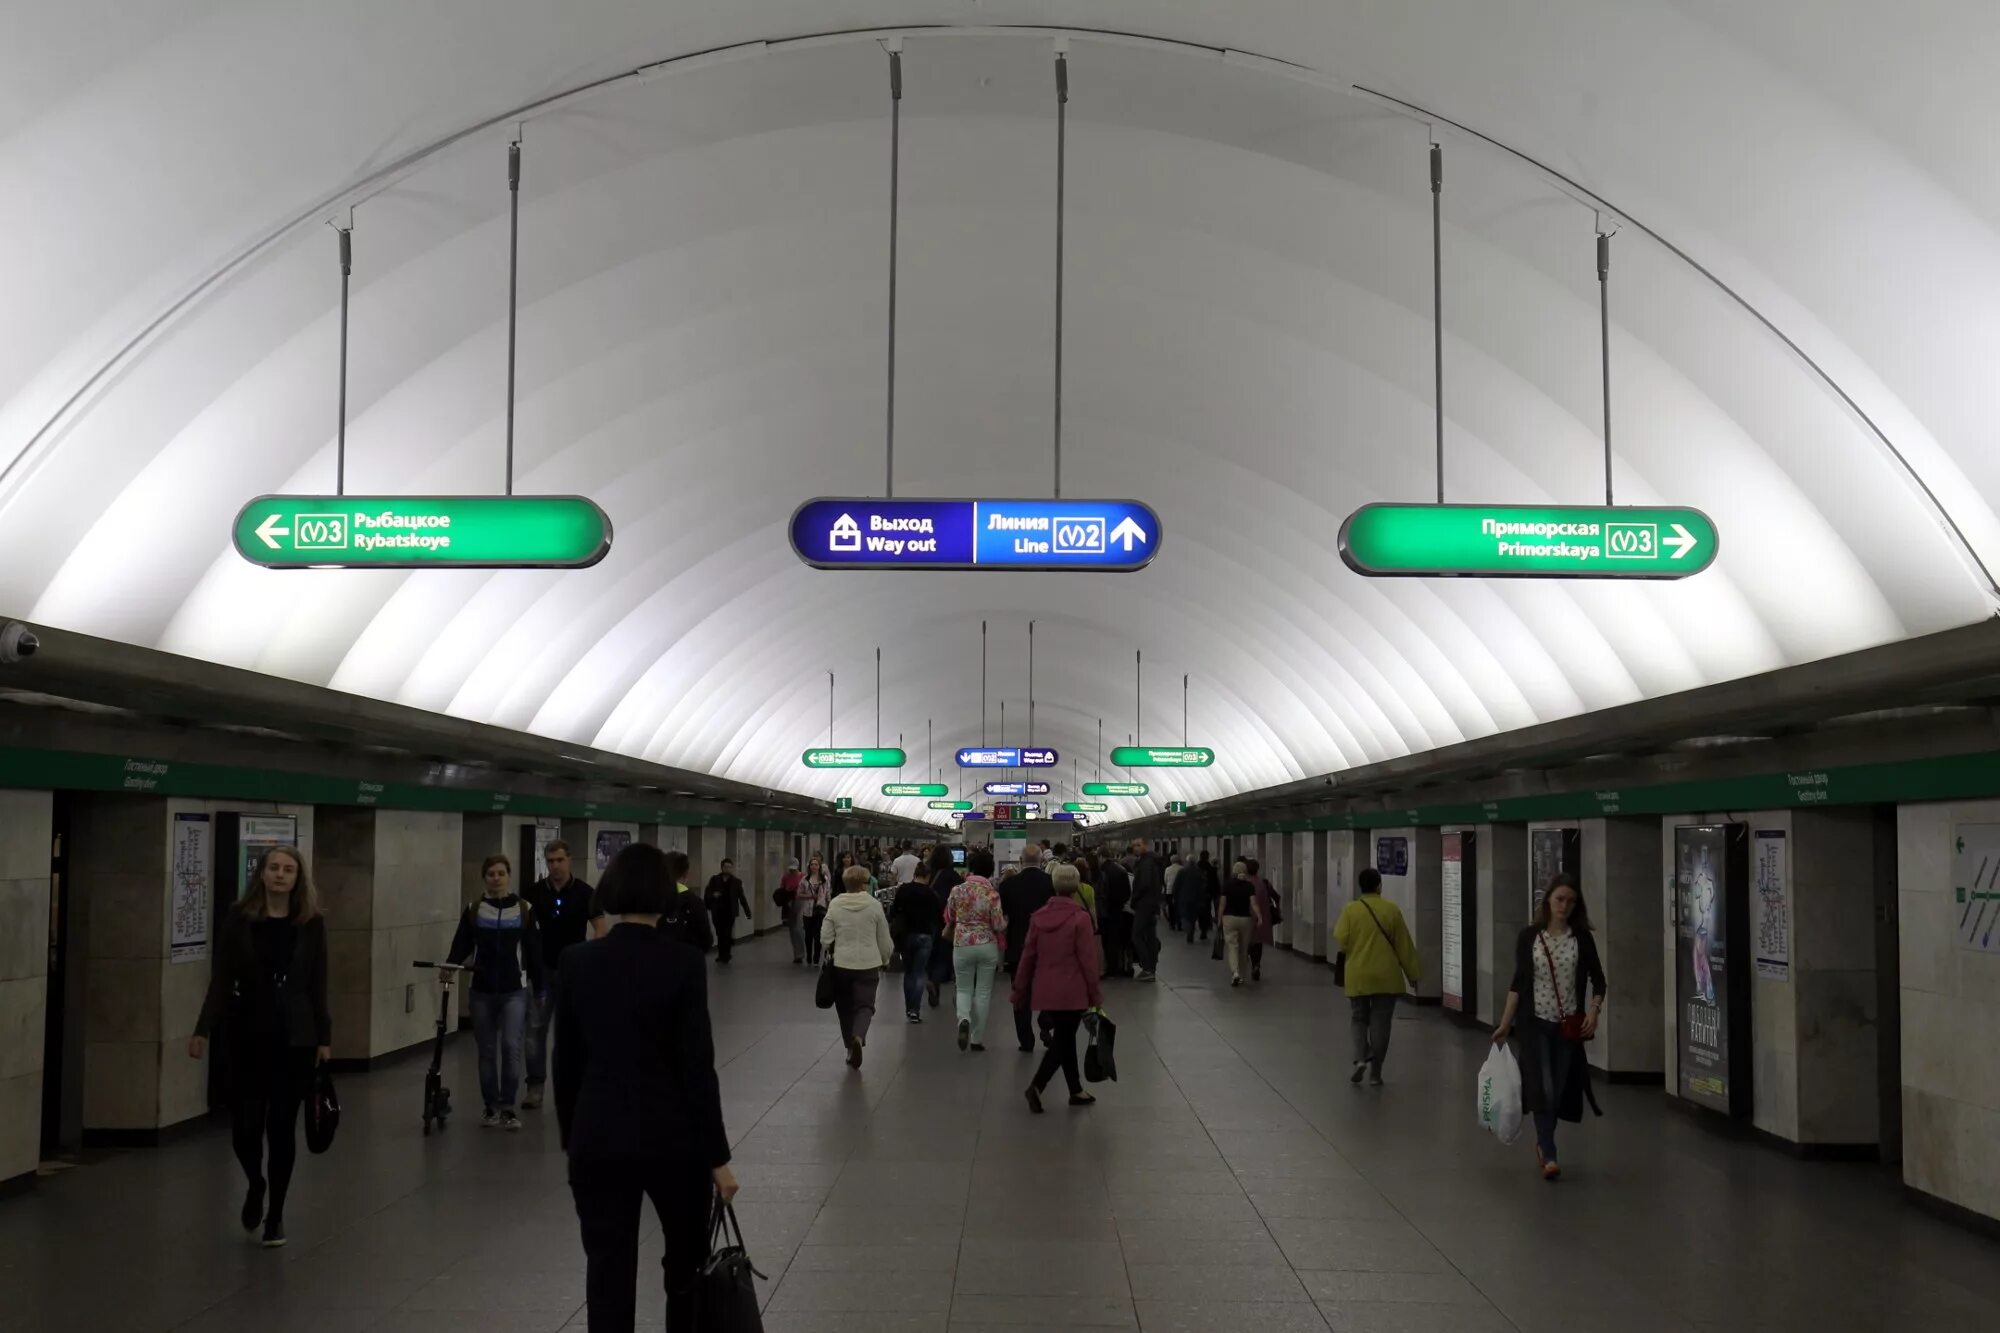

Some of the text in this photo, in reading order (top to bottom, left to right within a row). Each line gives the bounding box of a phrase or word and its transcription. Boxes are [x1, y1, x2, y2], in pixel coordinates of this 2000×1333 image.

[355, 512, 450, 529] Рыбацкое
[870, 515, 933, 533] Выход
[987, 514, 1049, 530] Линия
[1482, 518, 1600, 537] Приморская
[355, 533, 450, 551] Rybatskoye
[866, 537, 936, 554] Way out
[1014, 538, 1049, 553] Line
[1498, 541, 1600, 560] Primorskaya
[1482, 1076, 1493, 1122] PRISMA
